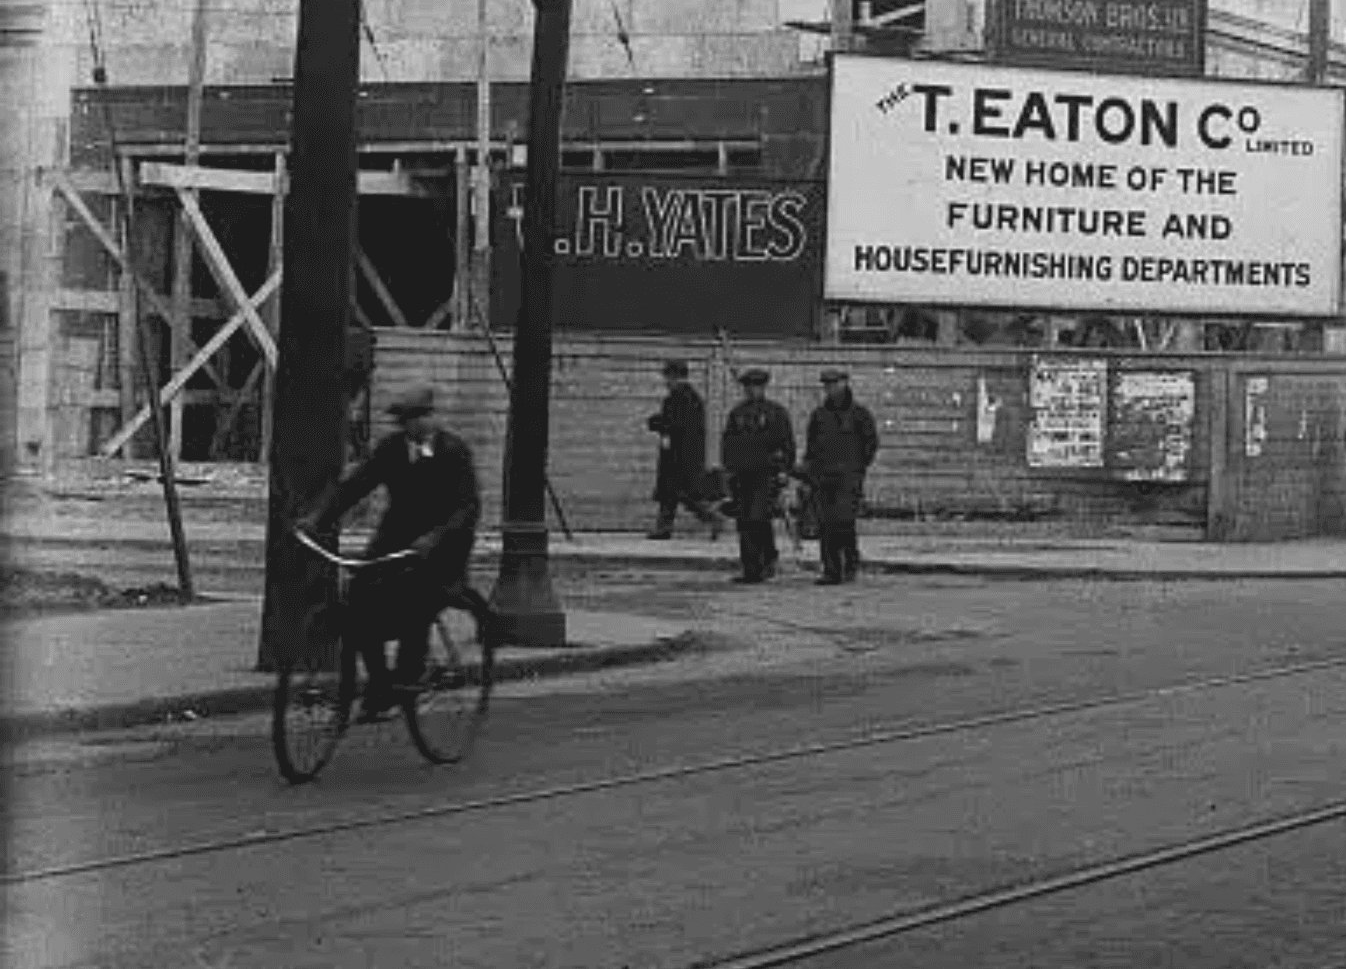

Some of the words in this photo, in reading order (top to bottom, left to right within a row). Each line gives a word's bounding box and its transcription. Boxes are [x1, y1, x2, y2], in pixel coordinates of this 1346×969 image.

[876, 83, 911, 115] THE
[972, 87, 1178, 148] EATON
[1245, 138, 1315, 157] LIMITED
[945, 153, 1015, 184] NEW
[1025, 159, 1118, 190] HOME
[1127, 165, 1168, 192] OF
[1176, 168, 1237, 196] THE
[947, 202, 1147, 237] FURNITURE
[1161, 213, 1233, 241] AND
[853, 244, 1112, 282] HOUSEFURNISHING
[1121, 255, 1312, 289] DEPARTMENTS
